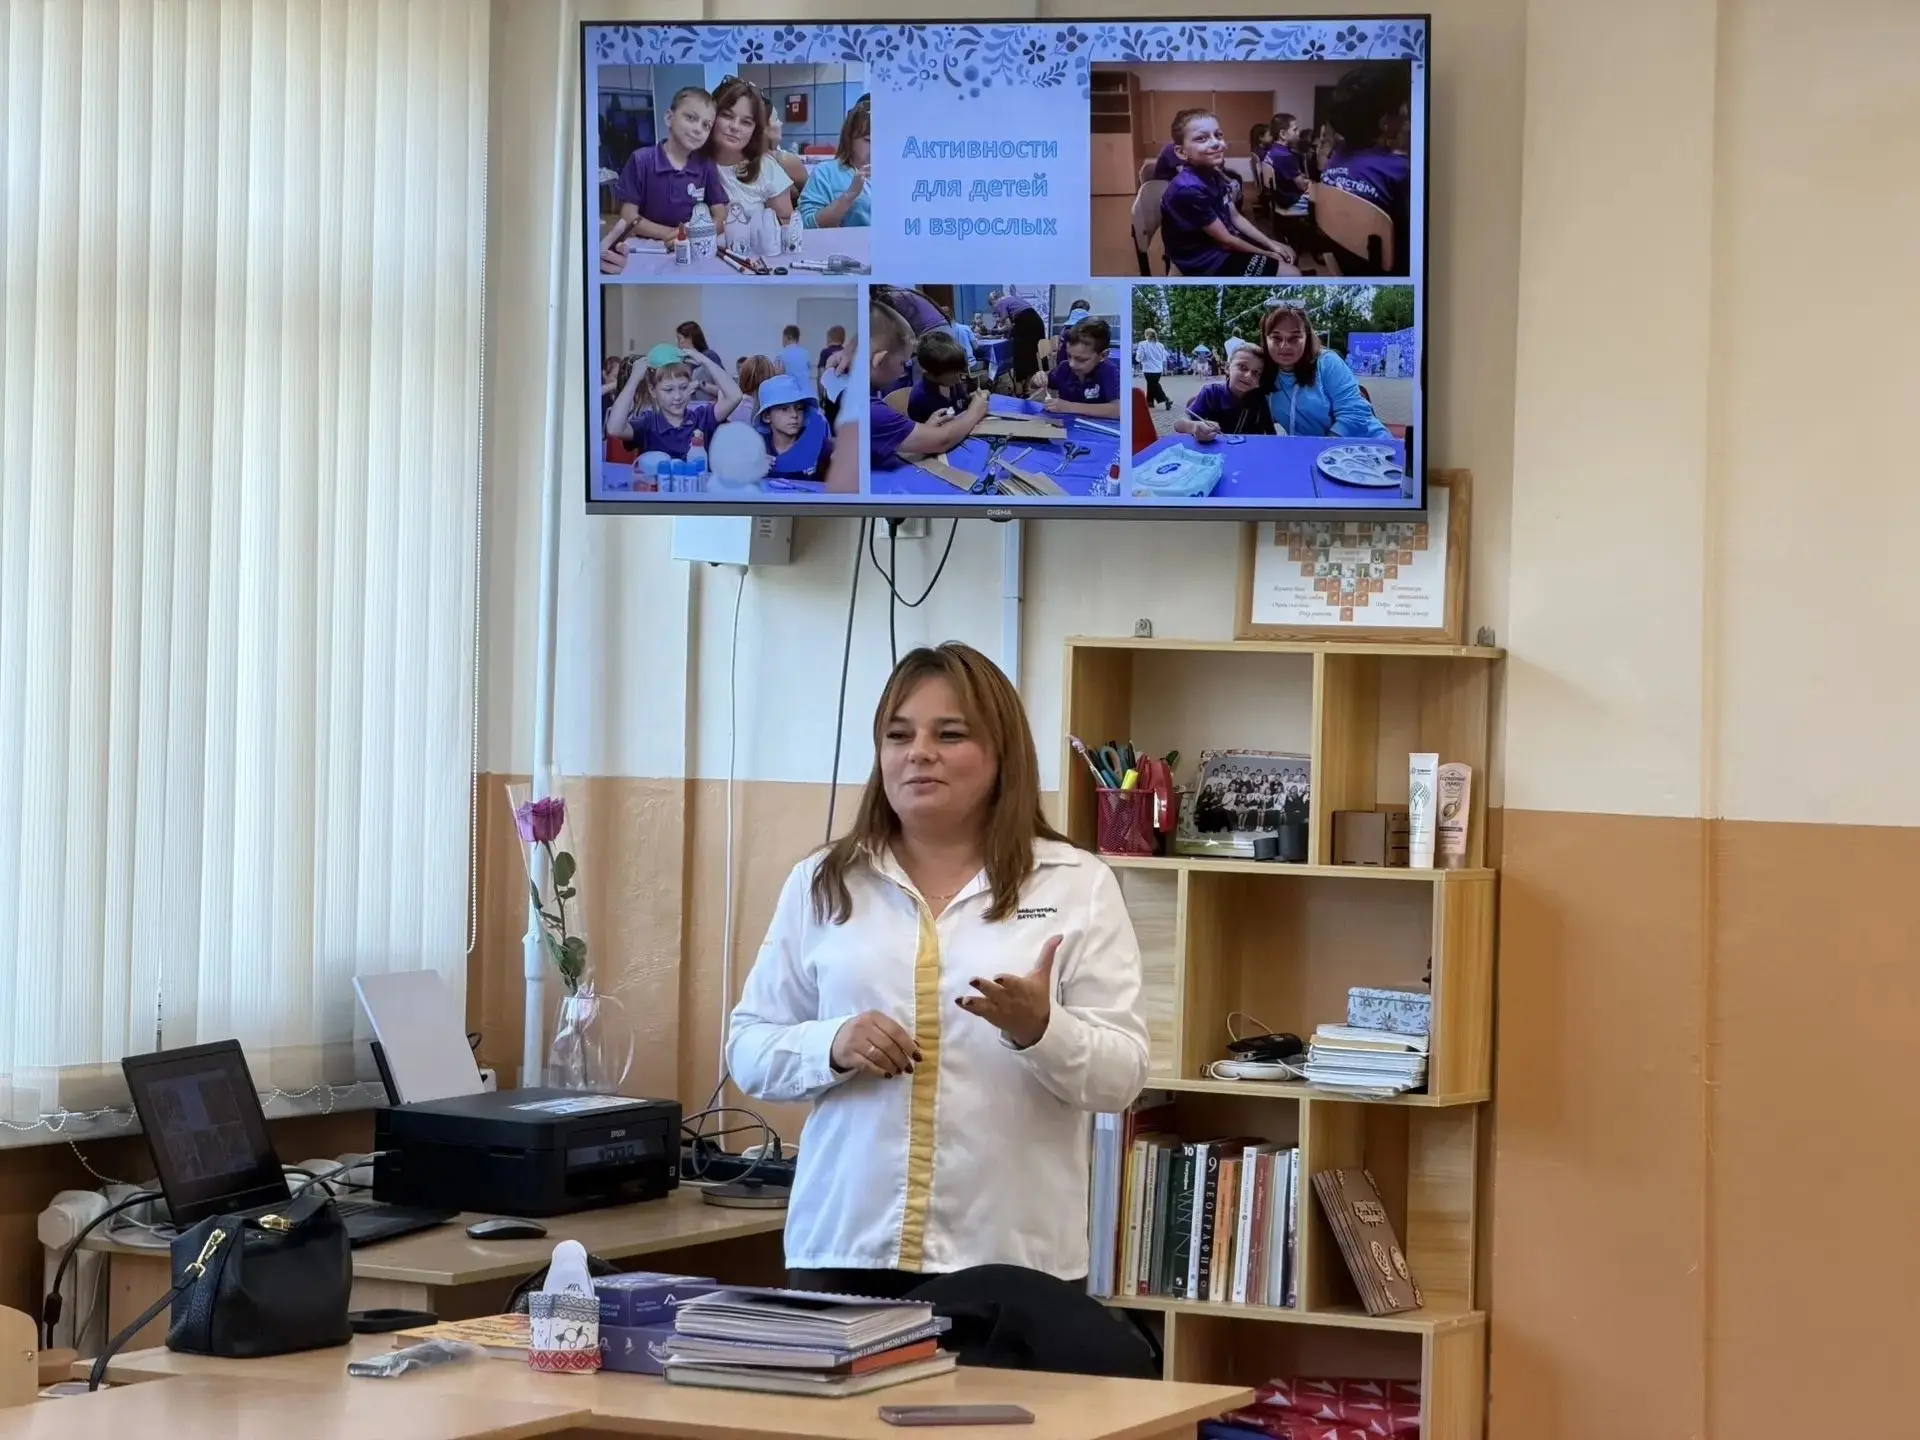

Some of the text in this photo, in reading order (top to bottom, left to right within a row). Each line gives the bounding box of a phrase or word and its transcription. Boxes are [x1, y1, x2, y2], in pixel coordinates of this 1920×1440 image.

[902, 135, 1058, 159] Активности
[911, 172, 1048, 202] для детей
[904, 216, 1058, 241] и взрослых
[1184, 1146, 1195, 1157] 10
[1208, 1156, 1218, 1174] 9
[1200, 1180, 1216, 1276] ГЕОГРАФИЯ
